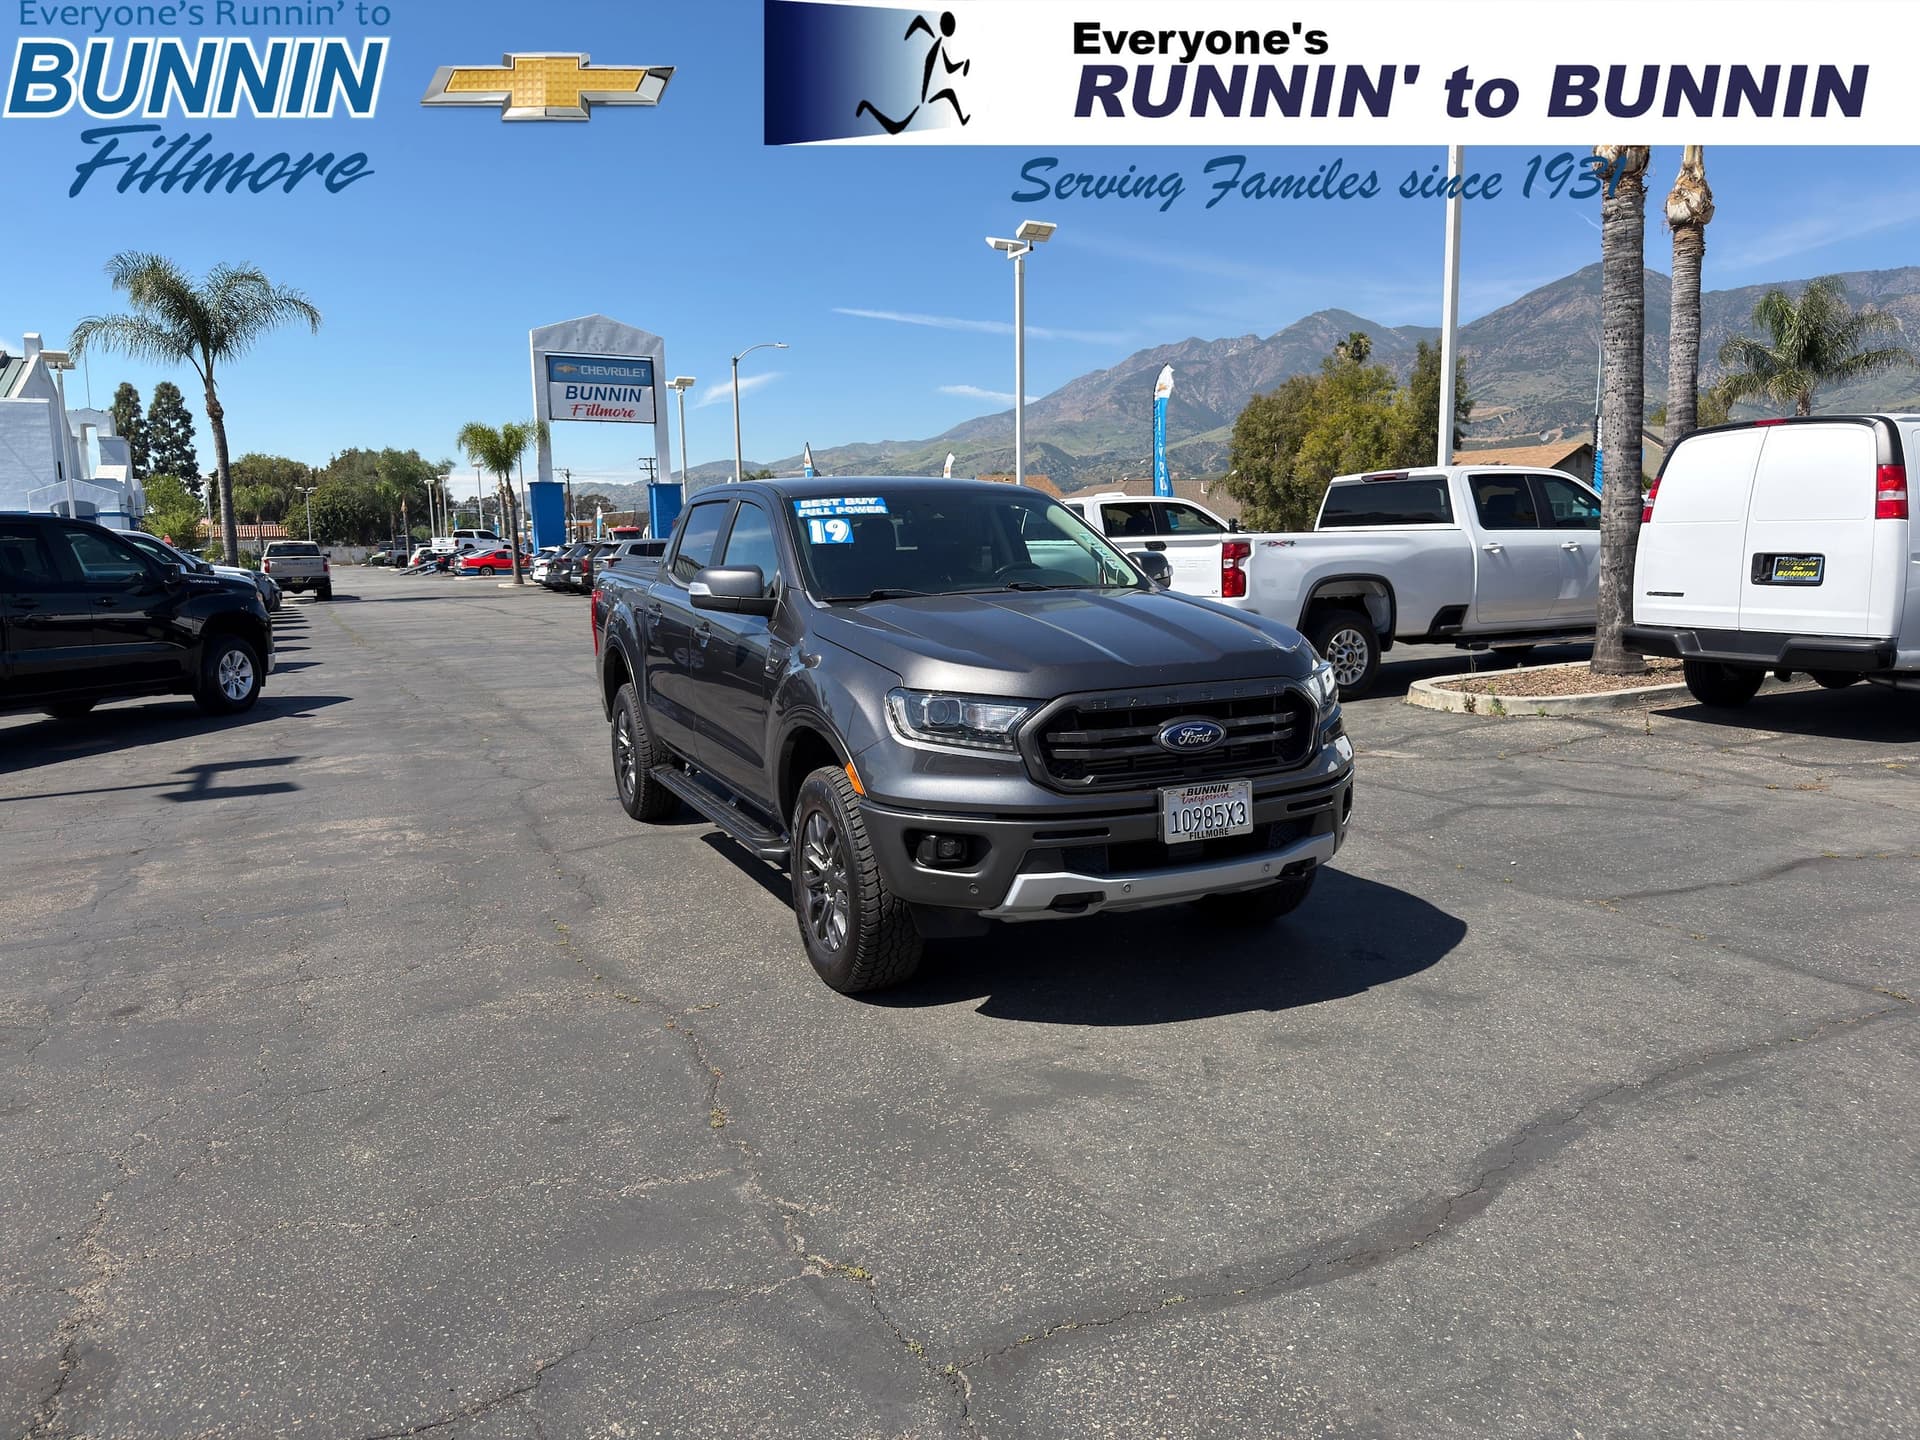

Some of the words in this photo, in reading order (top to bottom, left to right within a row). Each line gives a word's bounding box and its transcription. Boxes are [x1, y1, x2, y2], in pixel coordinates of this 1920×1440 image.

[580, 364, 646, 377] CHEVROLET
[565, 385, 642, 402] BUNNIN
[570, 403, 636, 418] Fillmore
[800, 498, 840, 508] BEST
[844, 497, 877, 505] BUY
[798, 508, 833, 517] FULL
[835, 505, 888, 514] POWER
[810, 519, 849, 543] 19
[1178, 727, 1213, 744] Ford
[1186, 784, 1230, 796] BUNNIN
[1171, 801, 1246, 834] 10985X3
[1189, 828, 1229, 840] FILLMORE
